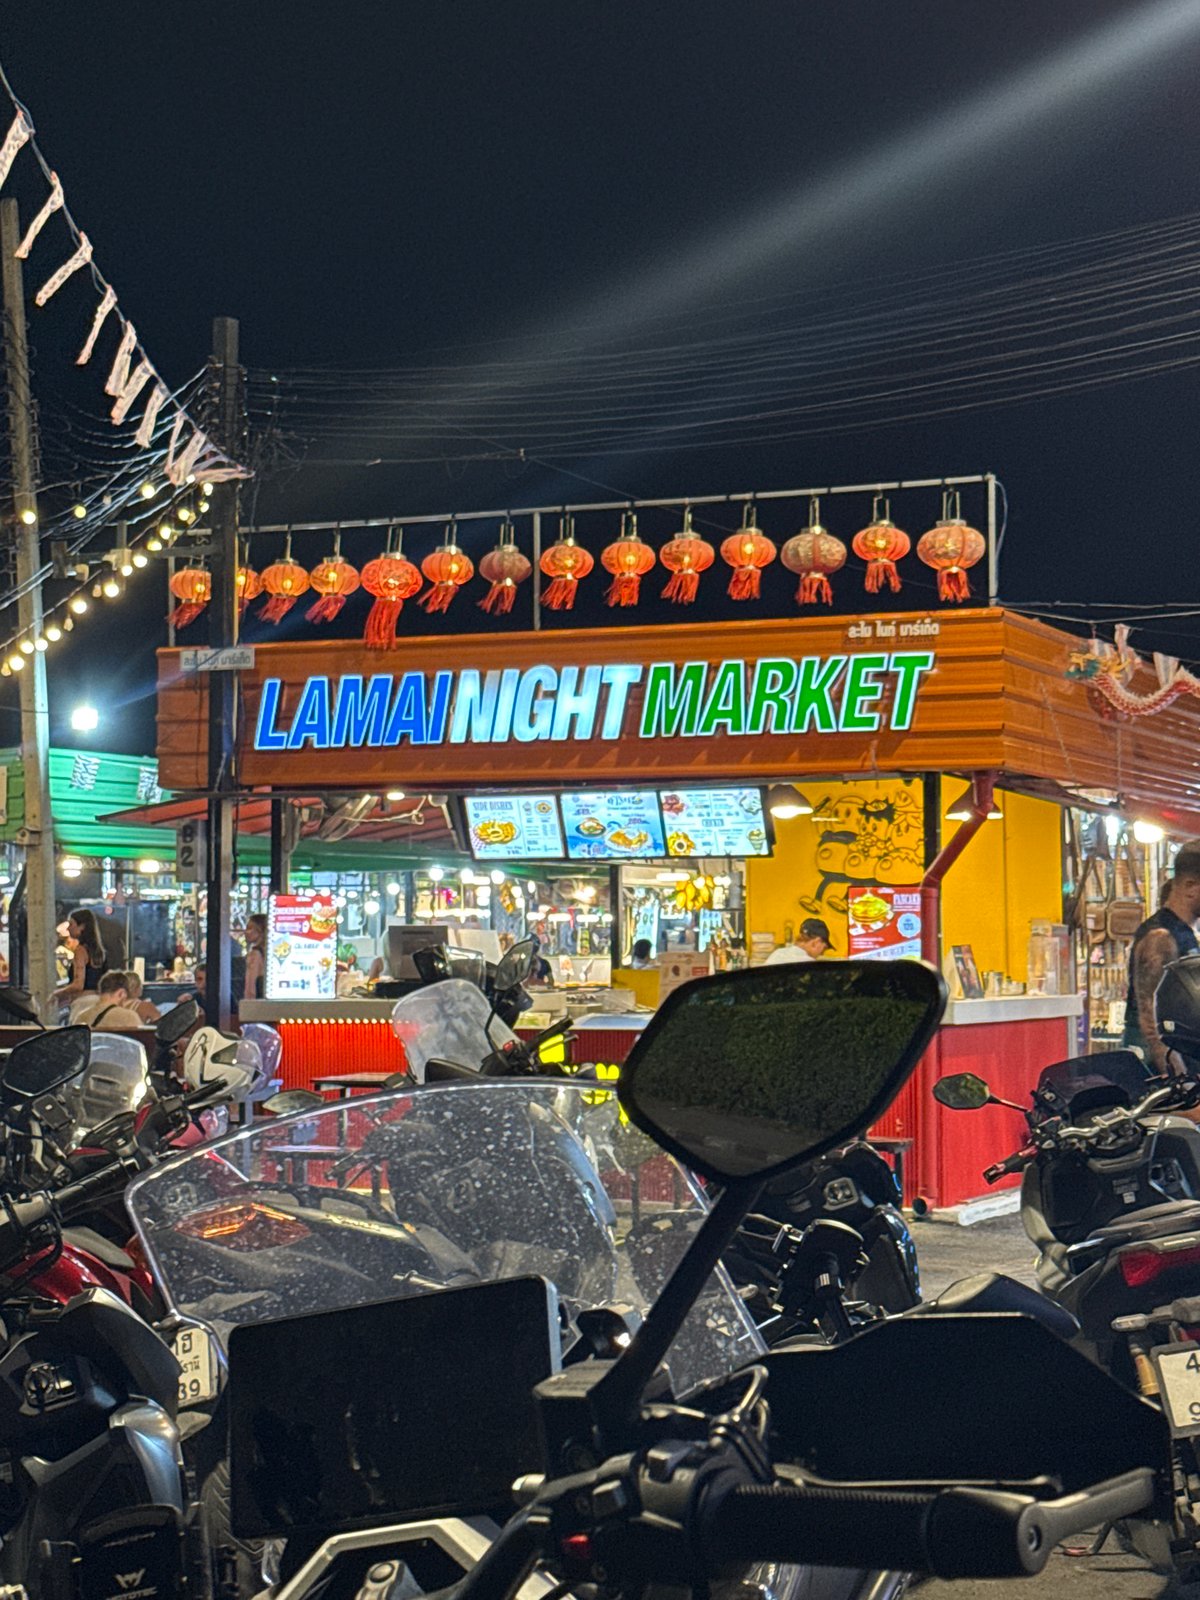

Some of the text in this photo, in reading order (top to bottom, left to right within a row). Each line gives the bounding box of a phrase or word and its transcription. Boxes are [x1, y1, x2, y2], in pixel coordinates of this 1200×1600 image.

[848, 621, 872, 638] ละไม
[900, 618, 939, 636] มาร์เก็ต
[254, 652, 934, 750] LAMAI NIGHT MARKET
